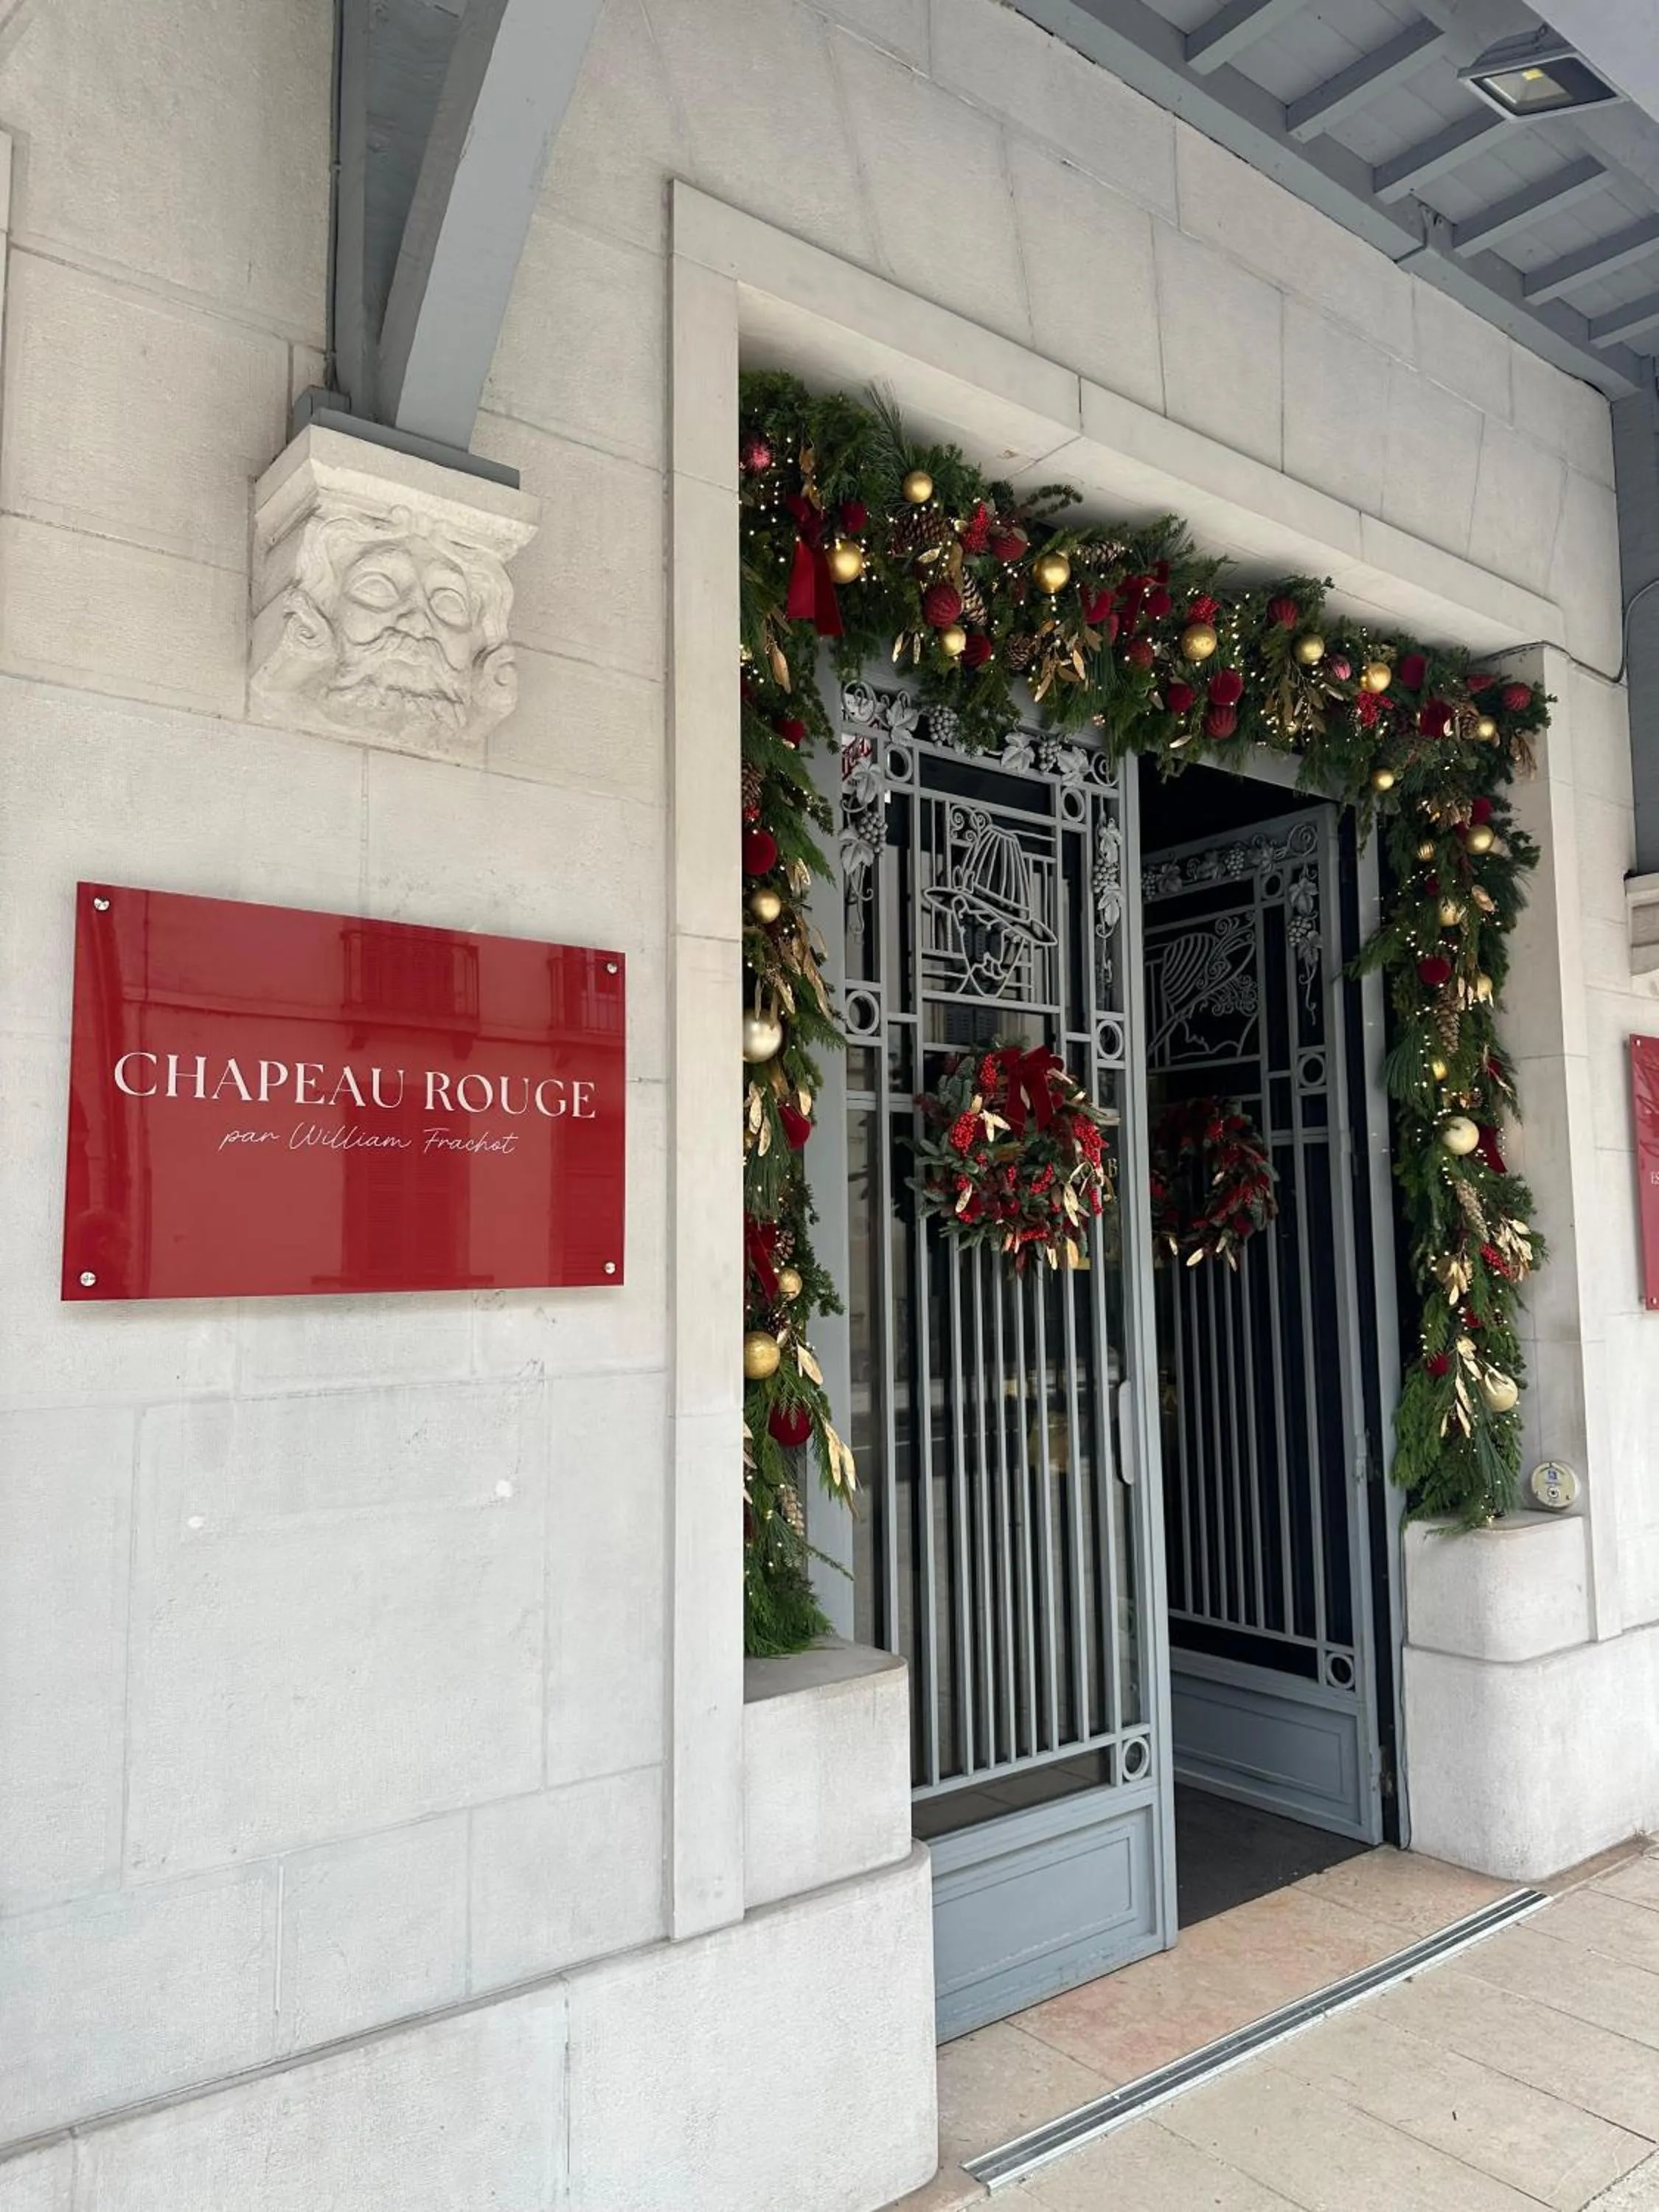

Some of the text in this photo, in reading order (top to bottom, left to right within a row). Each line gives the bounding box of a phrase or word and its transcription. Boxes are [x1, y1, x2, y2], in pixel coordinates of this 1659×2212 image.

[114, 1051, 596, 1119] CHAPEAU ROUGE
[218, 1121, 519, 1154] par William Frachot
